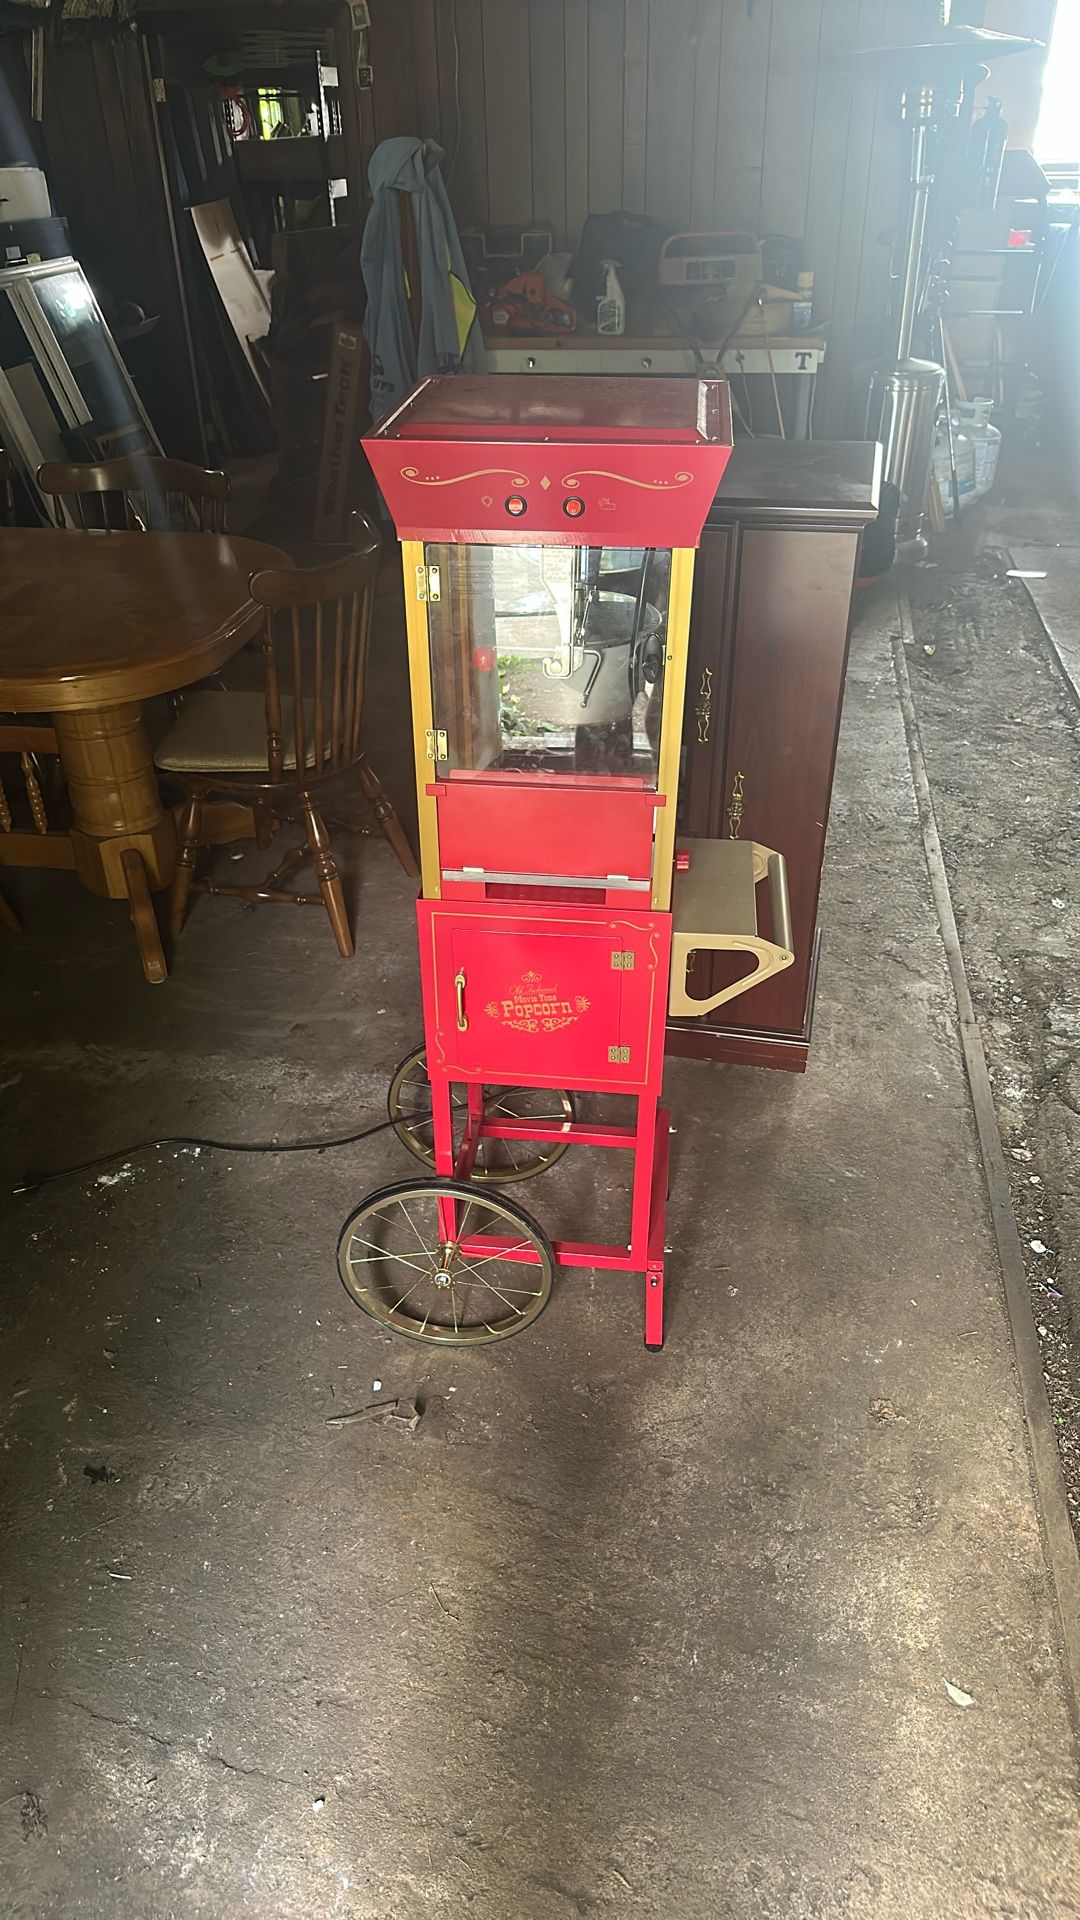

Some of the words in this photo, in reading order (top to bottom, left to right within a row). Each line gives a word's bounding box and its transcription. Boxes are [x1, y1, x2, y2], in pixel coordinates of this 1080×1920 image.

[795, 351, 812, 370] T
[513, 994, 537, 1003] Movie
[501, 1000, 573, 1018] Popcorn
